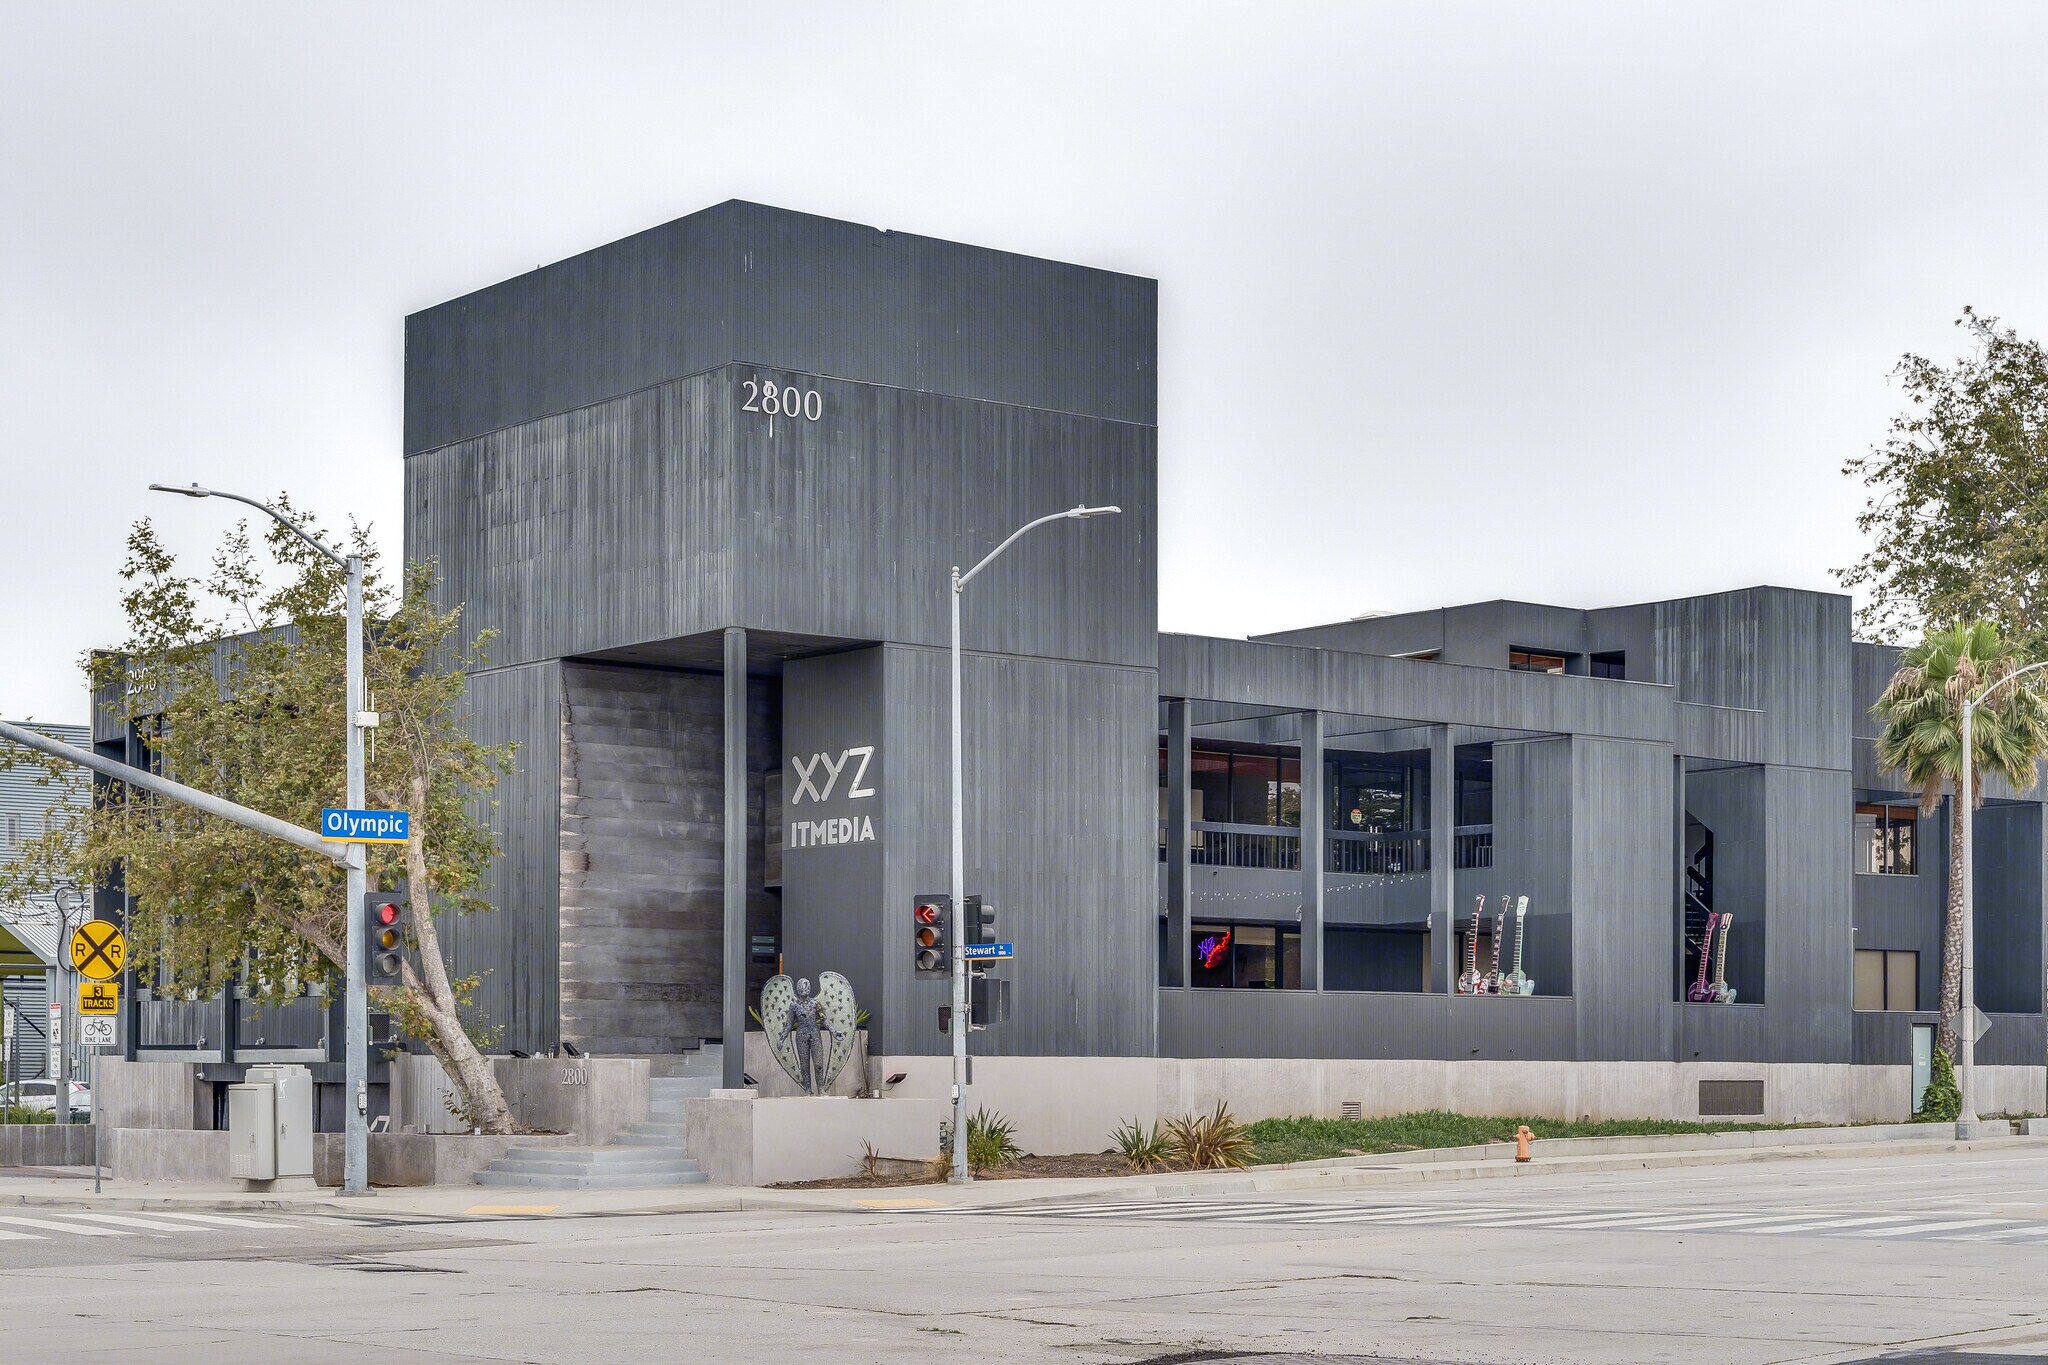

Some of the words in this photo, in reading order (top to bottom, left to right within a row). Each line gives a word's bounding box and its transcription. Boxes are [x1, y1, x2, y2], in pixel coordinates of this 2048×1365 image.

[741, 380, 823, 422] 2800
[791, 745, 876, 805] XYZ
[327, 812, 403, 837] Olympic
[791, 815, 876, 848] ITMEDIA
[75, 942, 86, 957] R
[111, 944, 121, 959] R
[965, 945, 996, 956] Stewart
[95, 987, 102, 997] 3
[83, 999, 114, 1008] TRACKS
[561, 1067, 589, 1086] 2800
